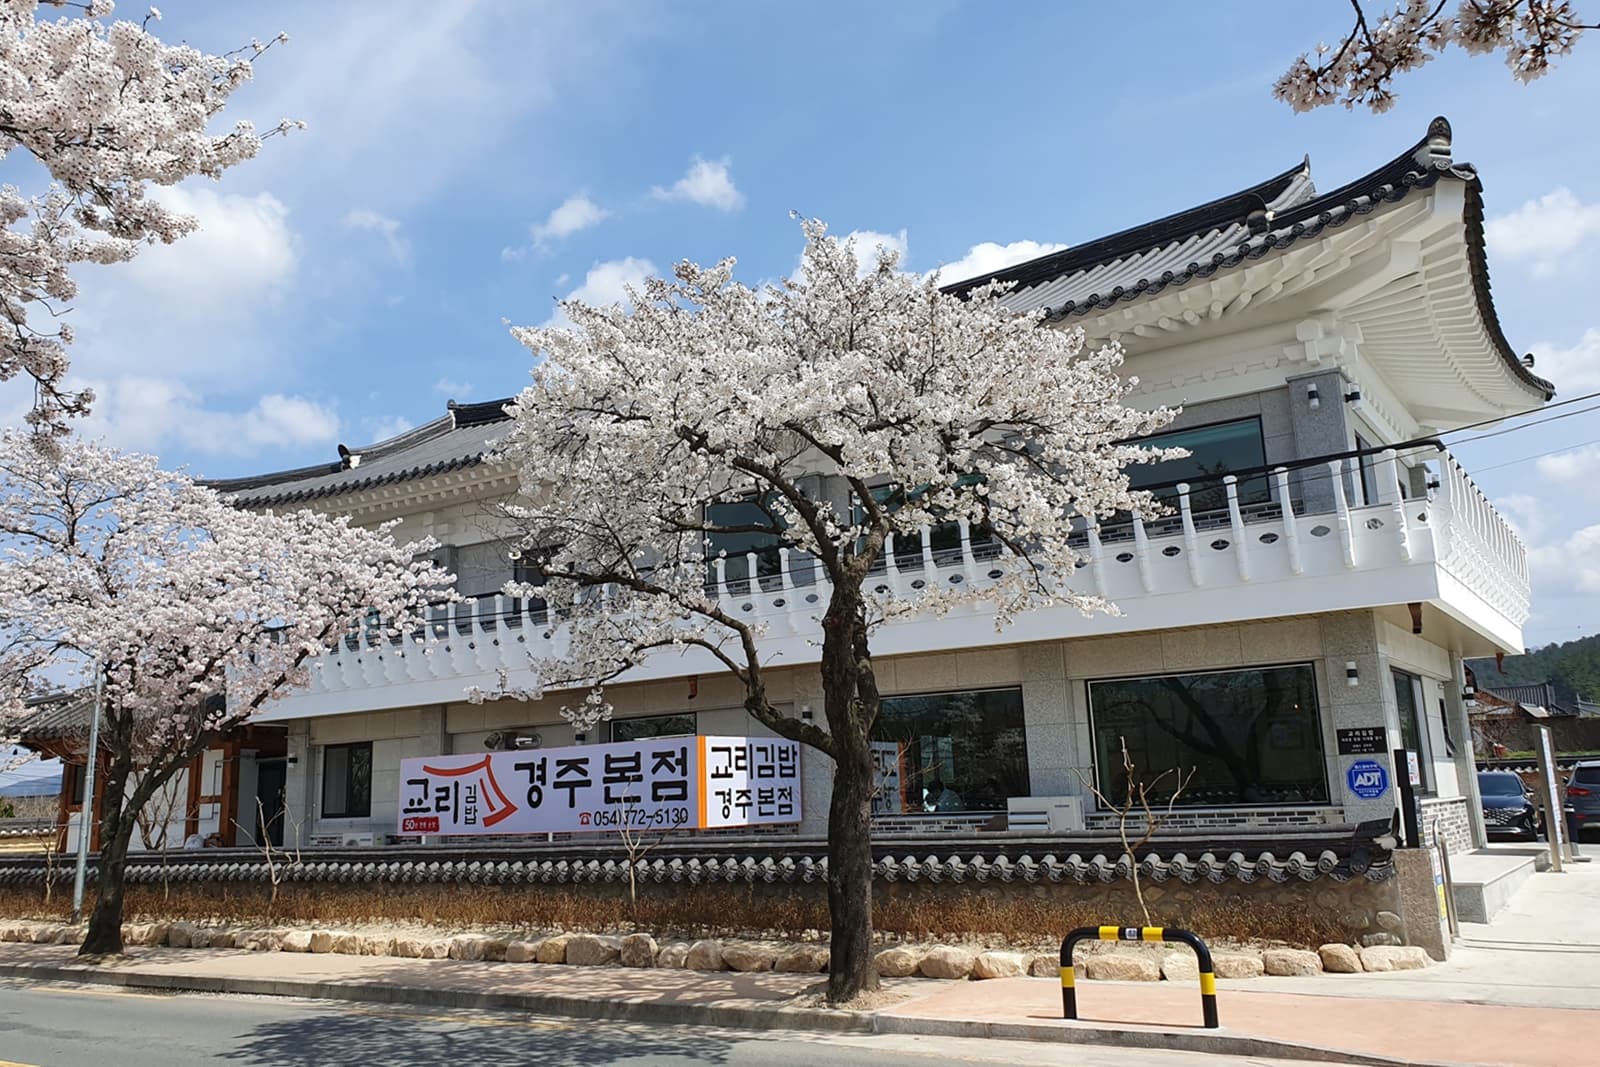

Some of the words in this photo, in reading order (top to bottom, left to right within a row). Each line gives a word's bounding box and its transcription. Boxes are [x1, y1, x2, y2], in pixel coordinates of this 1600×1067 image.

[711, 743, 798, 780] 교리김밥
[1354, 773, 1380, 786] ADT
[464, 784, 478, 825] 김밥
[714, 786, 793, 819] 경주본점
